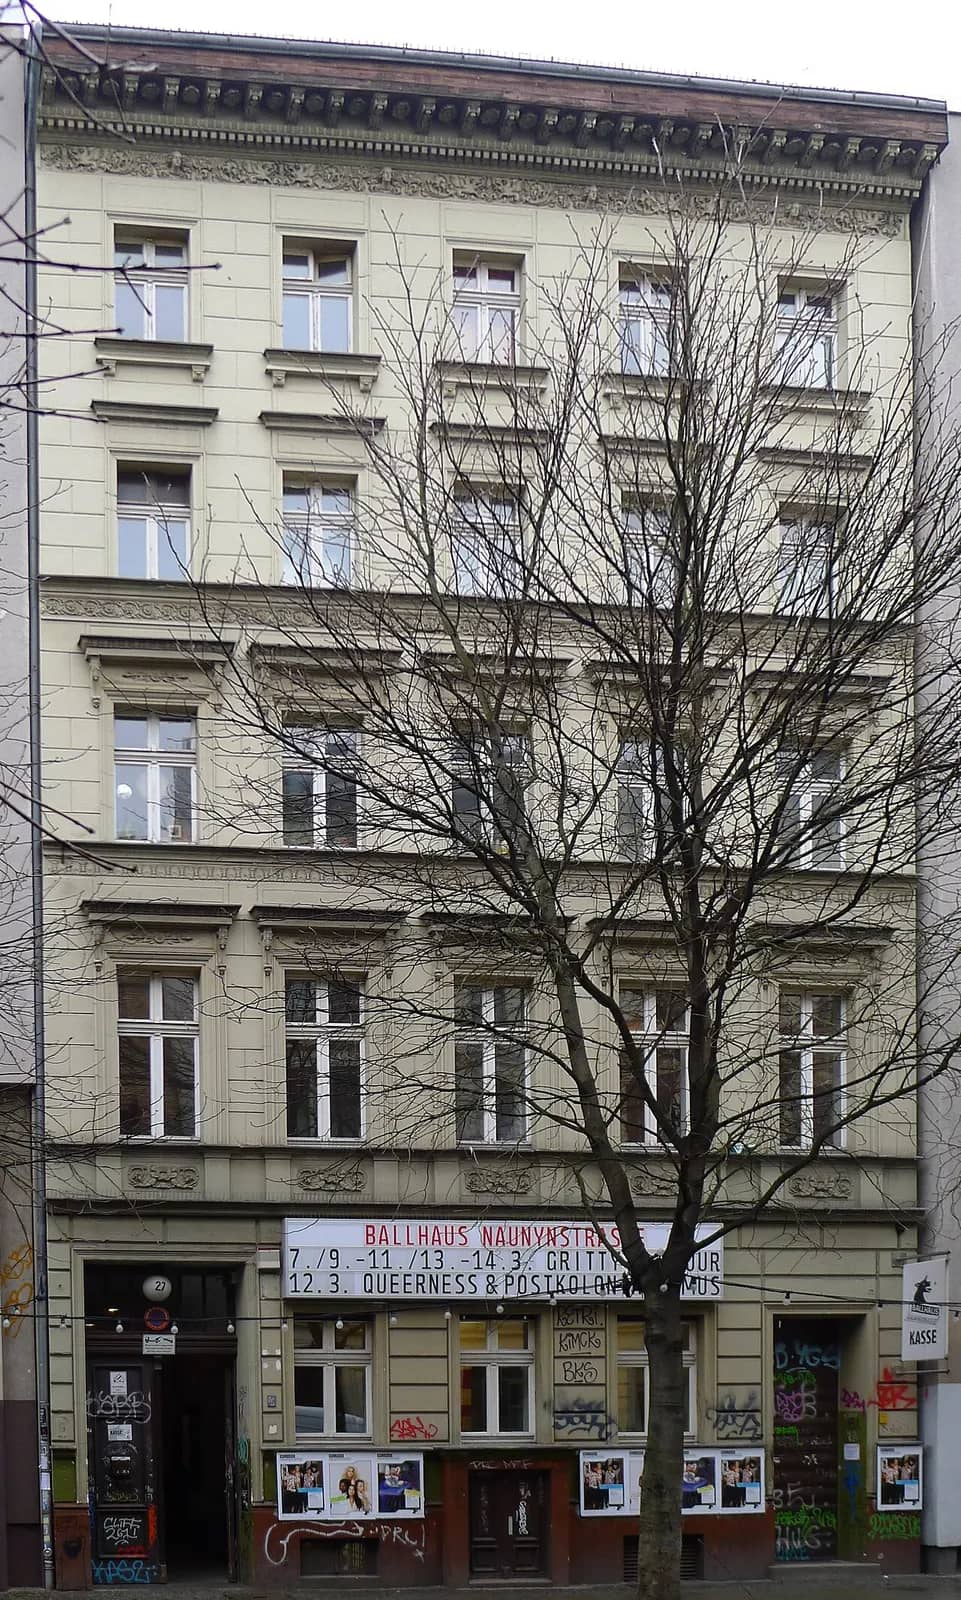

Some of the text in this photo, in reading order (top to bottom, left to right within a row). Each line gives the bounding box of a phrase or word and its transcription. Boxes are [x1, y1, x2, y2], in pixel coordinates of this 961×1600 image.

[365, 1224, 645, 1248] BALLHAUS NAUNYNSTRAS
[155, 1281, 166, 1292] 27
[363, 1273, 478, 1294] QUEERNESS
[909, 1329, 937, 1345] KASSE
